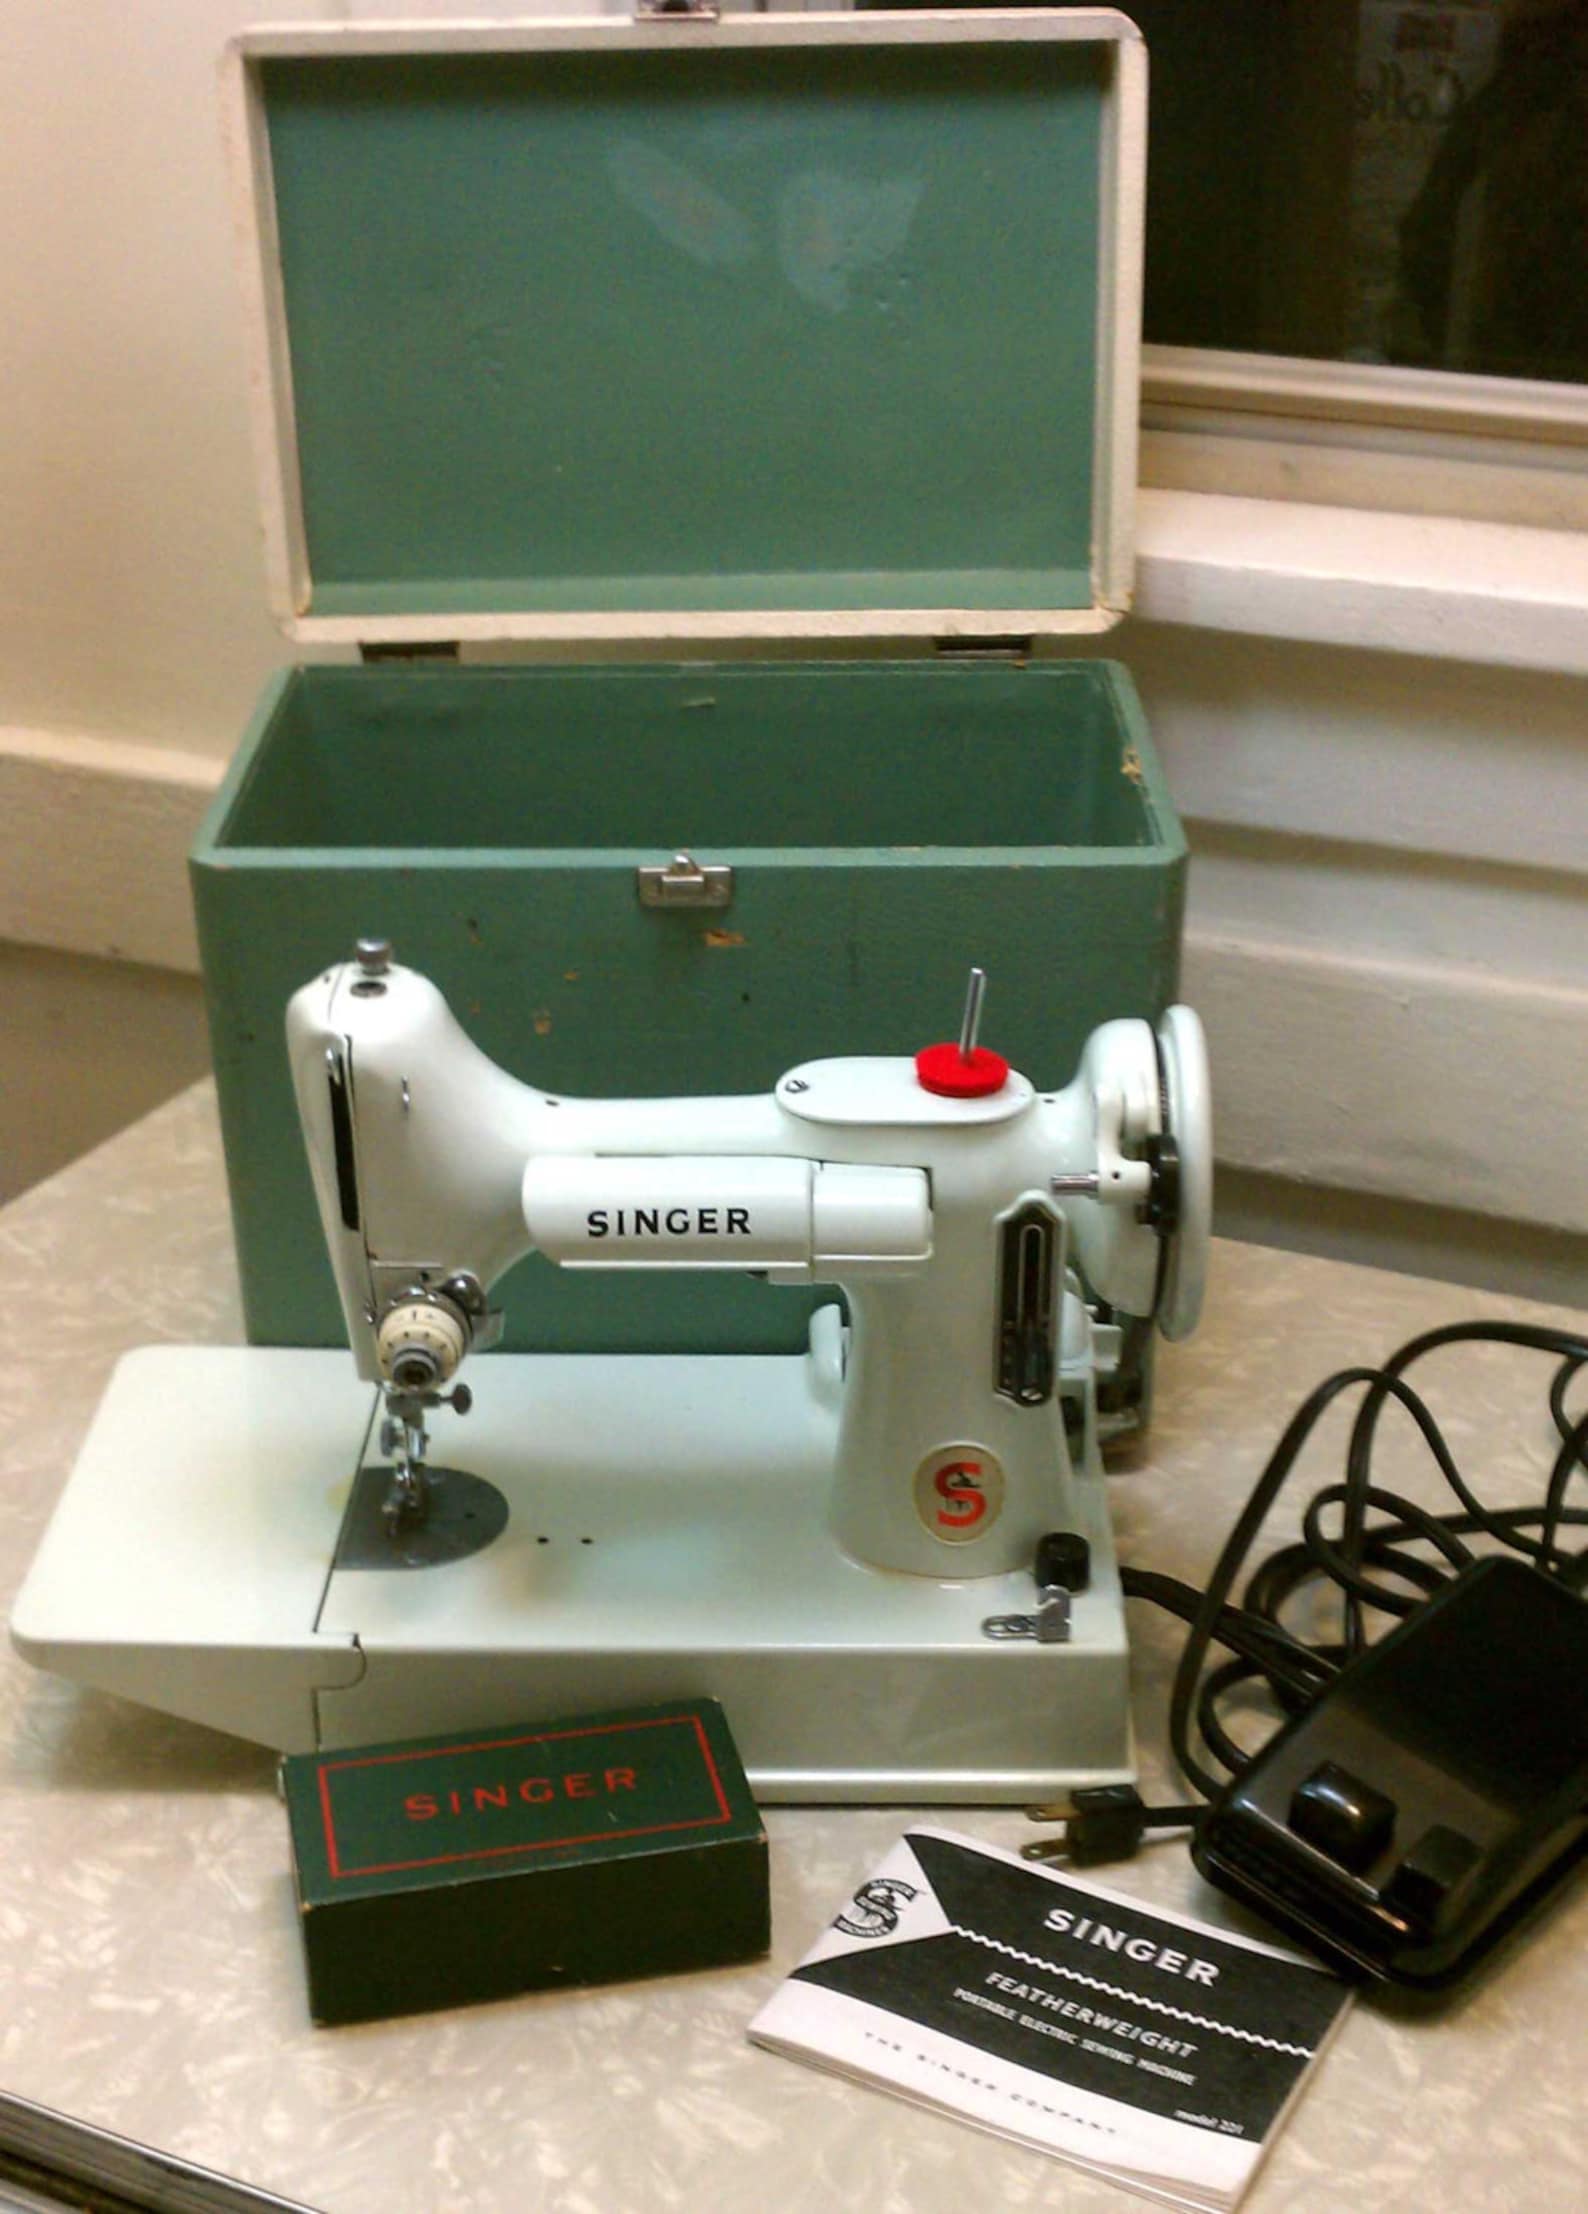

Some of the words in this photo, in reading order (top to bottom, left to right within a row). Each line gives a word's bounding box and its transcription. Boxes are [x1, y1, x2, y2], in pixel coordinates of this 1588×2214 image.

[587, 1207, 751, 1237] SINGER
[934, 1461, 988, 1528] S
[404, 1766, 638, 1820] SINGER
[1043, 1908, 1221, 1987] SINGER
[953, 1987, 1018, 2021] PORTABLE
[1018, 2013, 1080, 2046] ELECTRIC
[1079, 2038, 1137, 2065] SEWING
[1136, 2057, 1199, 2087] MACHINE
[985, 1972, 1199, 2058] FEATHERWEIGHT
